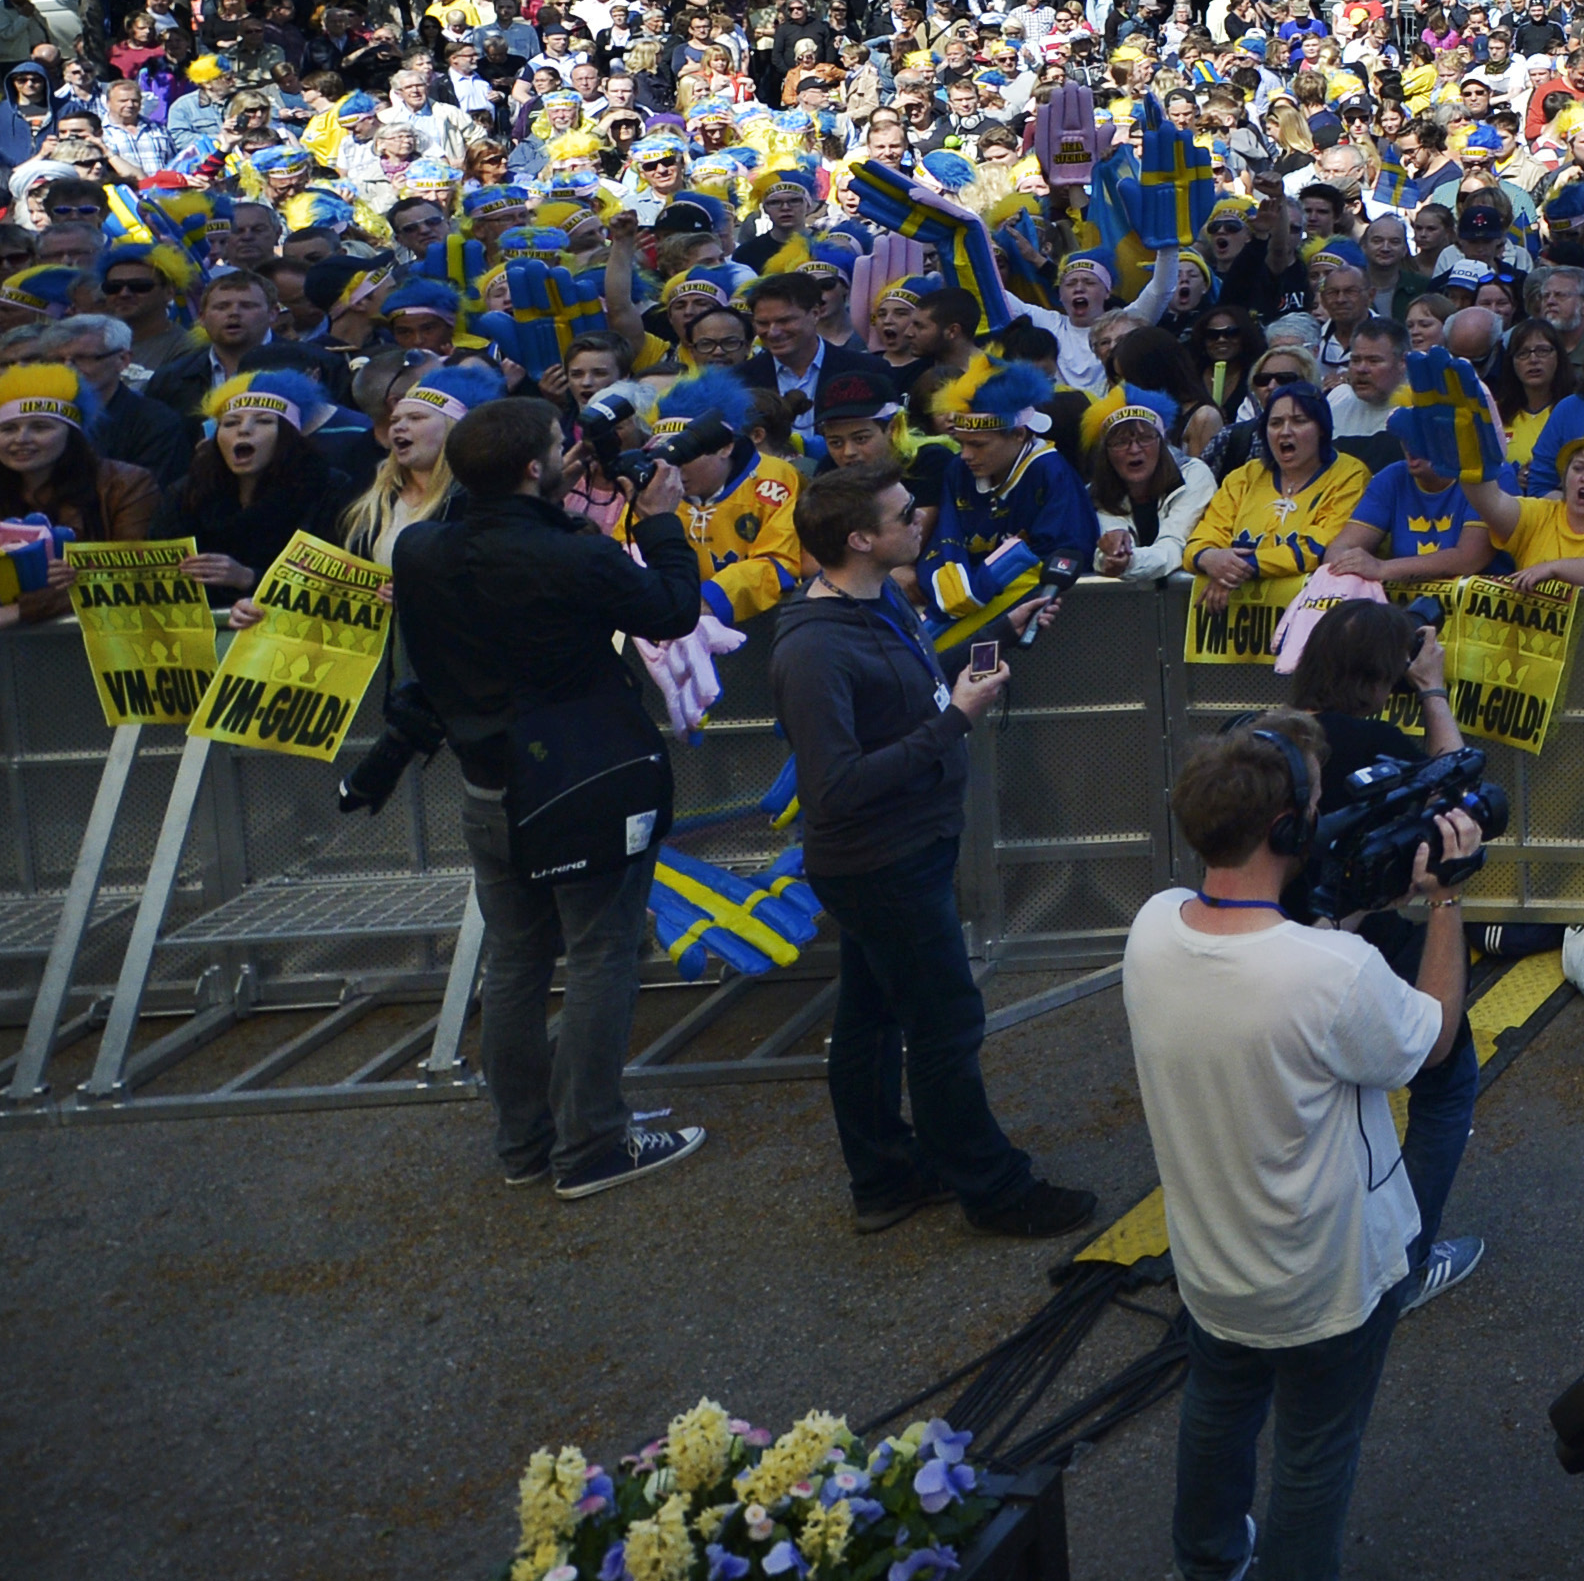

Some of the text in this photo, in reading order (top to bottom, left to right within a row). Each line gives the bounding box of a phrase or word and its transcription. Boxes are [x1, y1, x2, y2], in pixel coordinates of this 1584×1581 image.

[755, 479, 790, 503] AXA
[68, 545, 188, 570] AFTONBLADET
[288, 542, 392, 590] AFTONBLADET
[80, 580, 201, 608] JAAAAA!
[259, 580, 385, 631] JAAAAA!
[1465, 593, 1567, 636] JAAAAA!
[103, 668, 215, 717] VM-GULD
[205, 674, 351, 751] VM-GULD!
